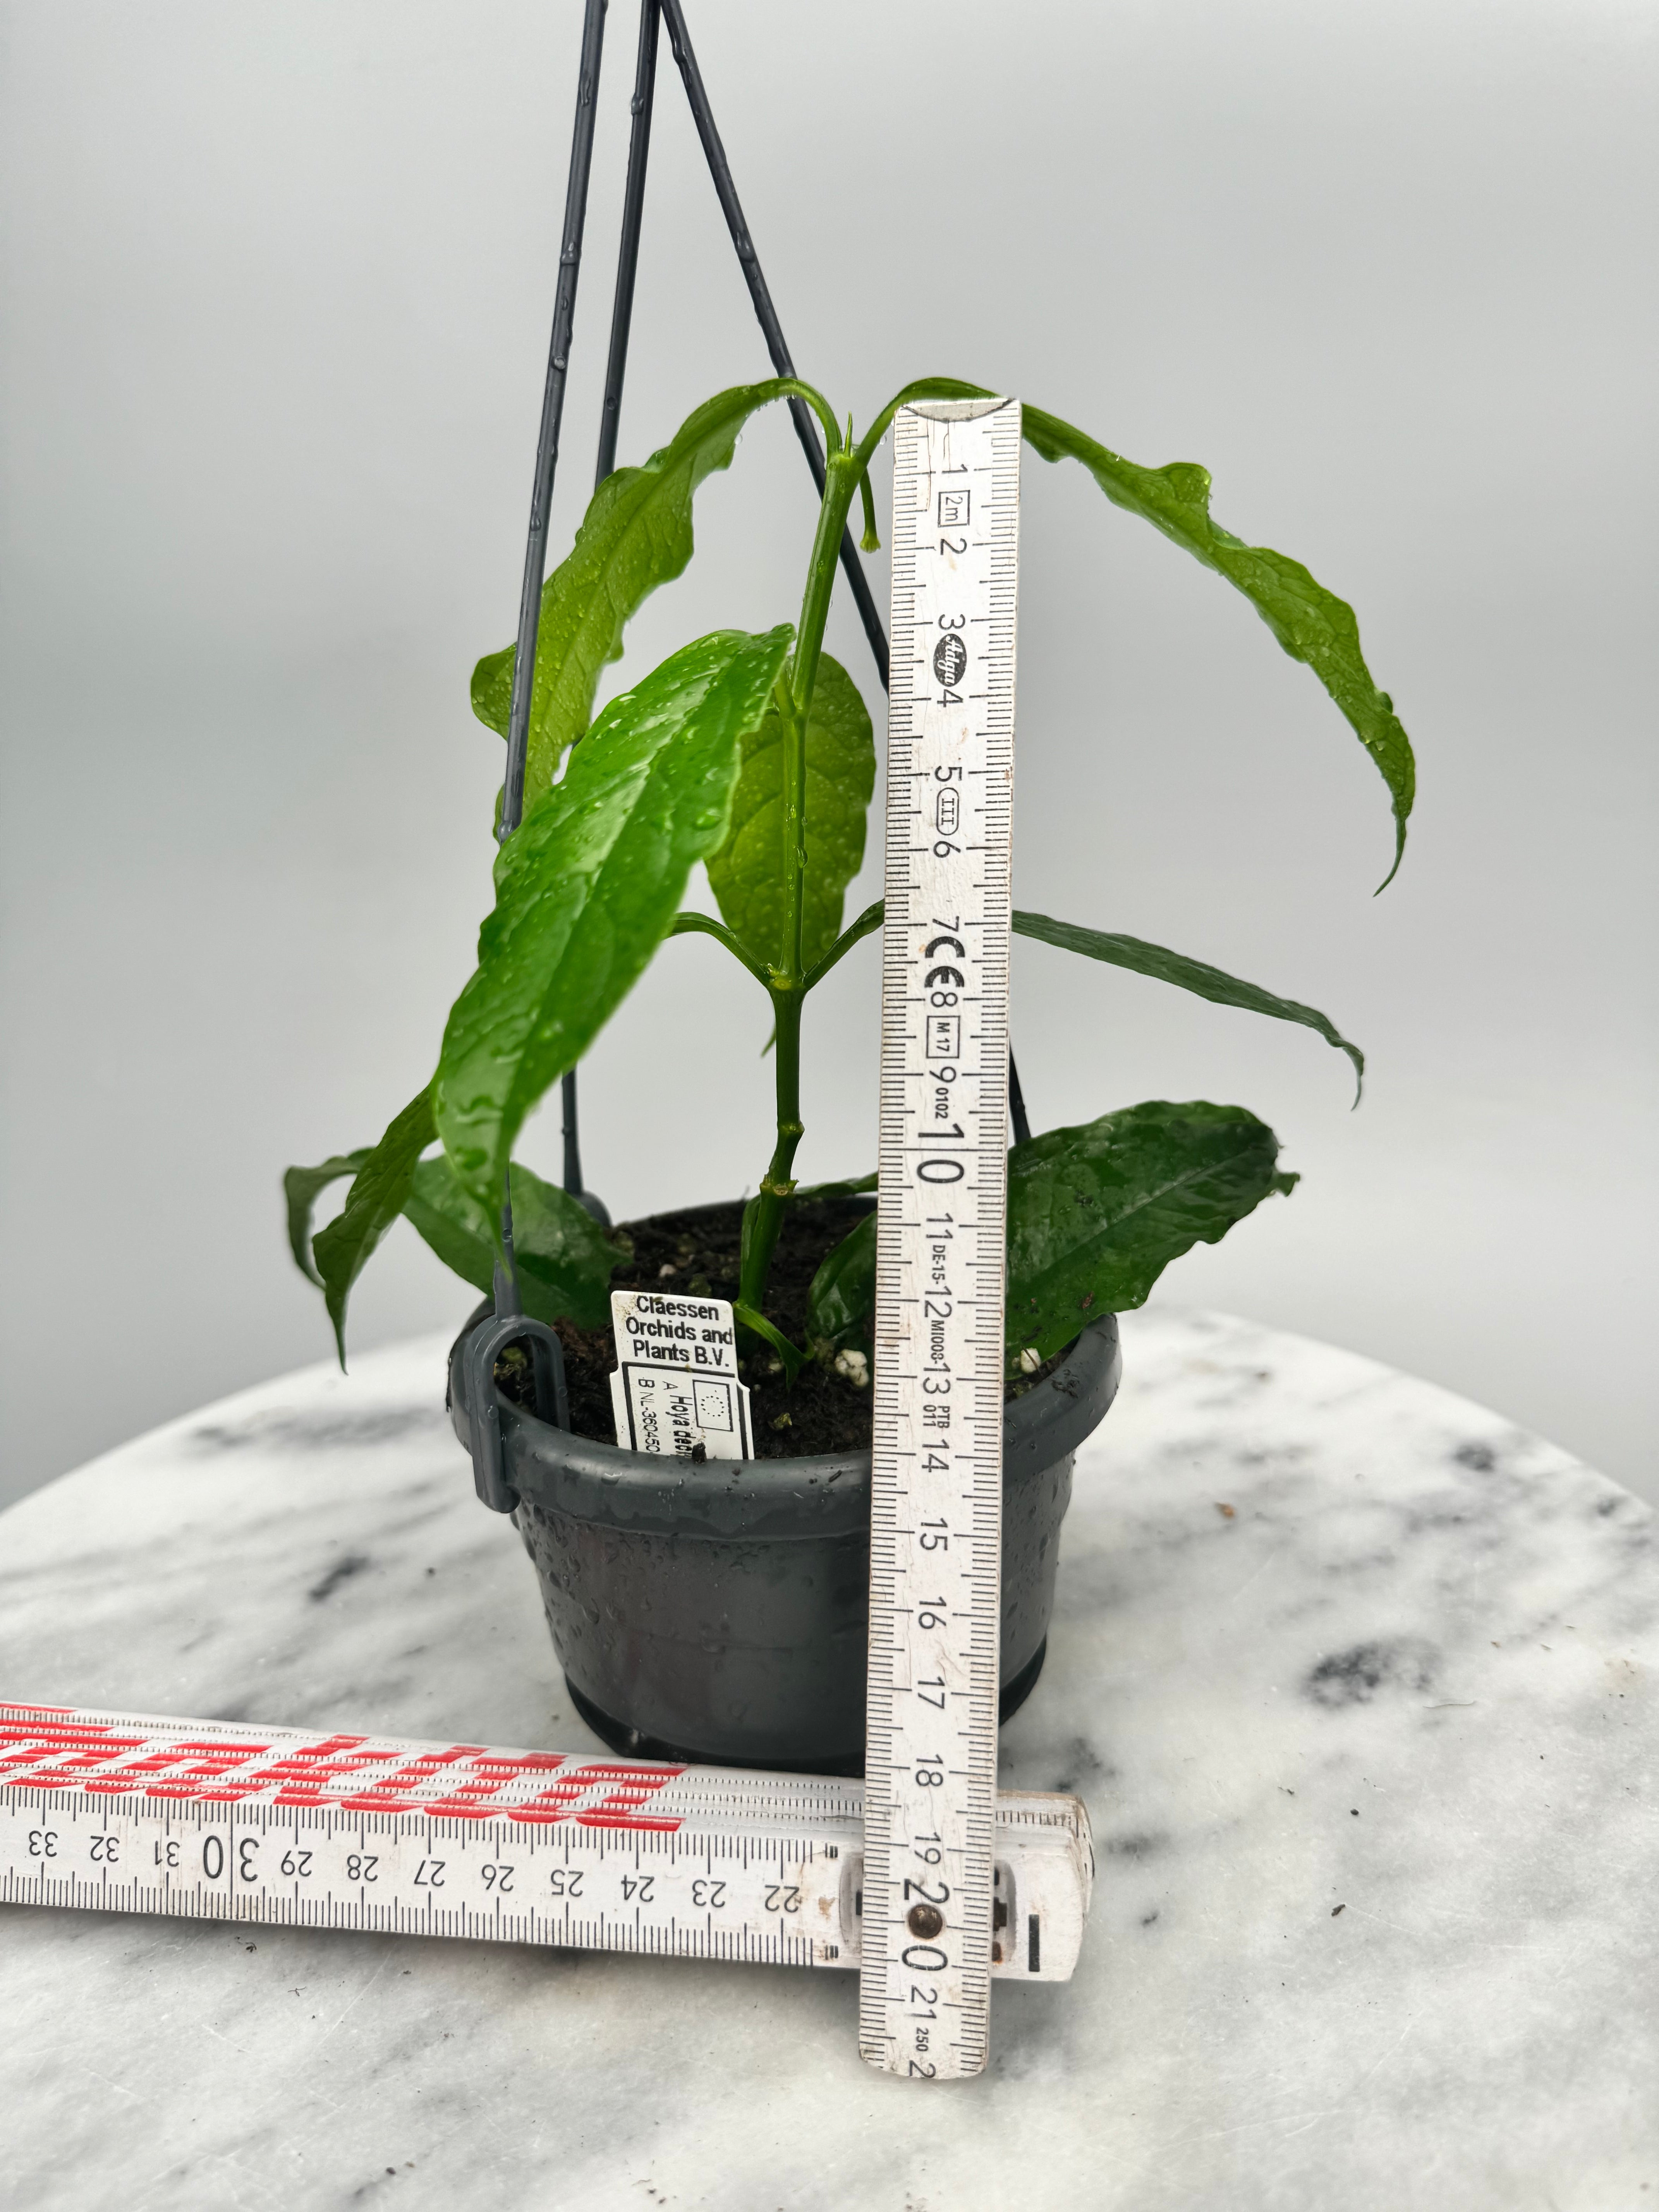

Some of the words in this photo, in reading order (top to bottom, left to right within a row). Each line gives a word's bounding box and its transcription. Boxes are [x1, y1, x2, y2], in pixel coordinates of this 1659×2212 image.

[942, 464, 969, 474] 1
[945, 496, 963, 522] 2m
[940, 538, 967, 556] 2
[938, 614, 965, 630] 3
[937, 636, 963, 684] Adga
[937, 690, 964, 708] 4
[934, 766, 962, 782] 5
[933, 841, 961, 858] 6
[933, 916, 959, 932] 7
[931, 992, 958, 1007] 8
[936, 1039, 950, 1052] 17
[929, 1066, 956, 1082] 9
[935, 1087, 948, 1119] 0102
[917, 1124, 964, 1183] 10
[926, 1213, 953, 1239] 11
[636, 1296, 719, 1321] Claessen
[924, 1286, 952, 1318] 12
[625, 1316, 697, 1341] Orchids
[702, 1327, 732, 1345] and
[633, 1340, 690, 1362] Plants
[694, 1346, 729, 1367] B.V.
[638, 1378, 655, 1388] B
[662, 1381, 678, 1390] A
[923, 1362, 951, 1394] 13
[639, 1392, 660, 1454] NL-360450
[666, 1395, 692, 1427] Hoya
[923, 1405, 936, 1427] 011
[937, 1406, 950, 1429] PTB
[922, 1439, 950, 1472] 14
[920, 1518, 948, 1551] 15
[919, 1596, 947, 1630] 16
[918, 1676, 945, 1709] 17
[915, 1754, 944, 1787] 18
[29, 1831, 58, 1856] 33
[90, 1835, 120, 1862] 32
[155, 1841, 180, 1867] 31
[914, 1832, 941, 1865] 19
[203, 1835, 259, 1881] 30
[280, 1850, 313, 1877] 29
[347, 1854, 379, 1881] 28
[414, 1860, 446, 1886] 27
[481, 1864, 514, 1891] 26
[551, 1869, 584, 1898] 25
[621, 1874, 654, 1902] 24
[692, 1880, 726, 1908] 23
[764, 1884, 800, 1913] 22
[908, 1984, 938, 2020] 21
[916, 2027, 929, 2052] 250
